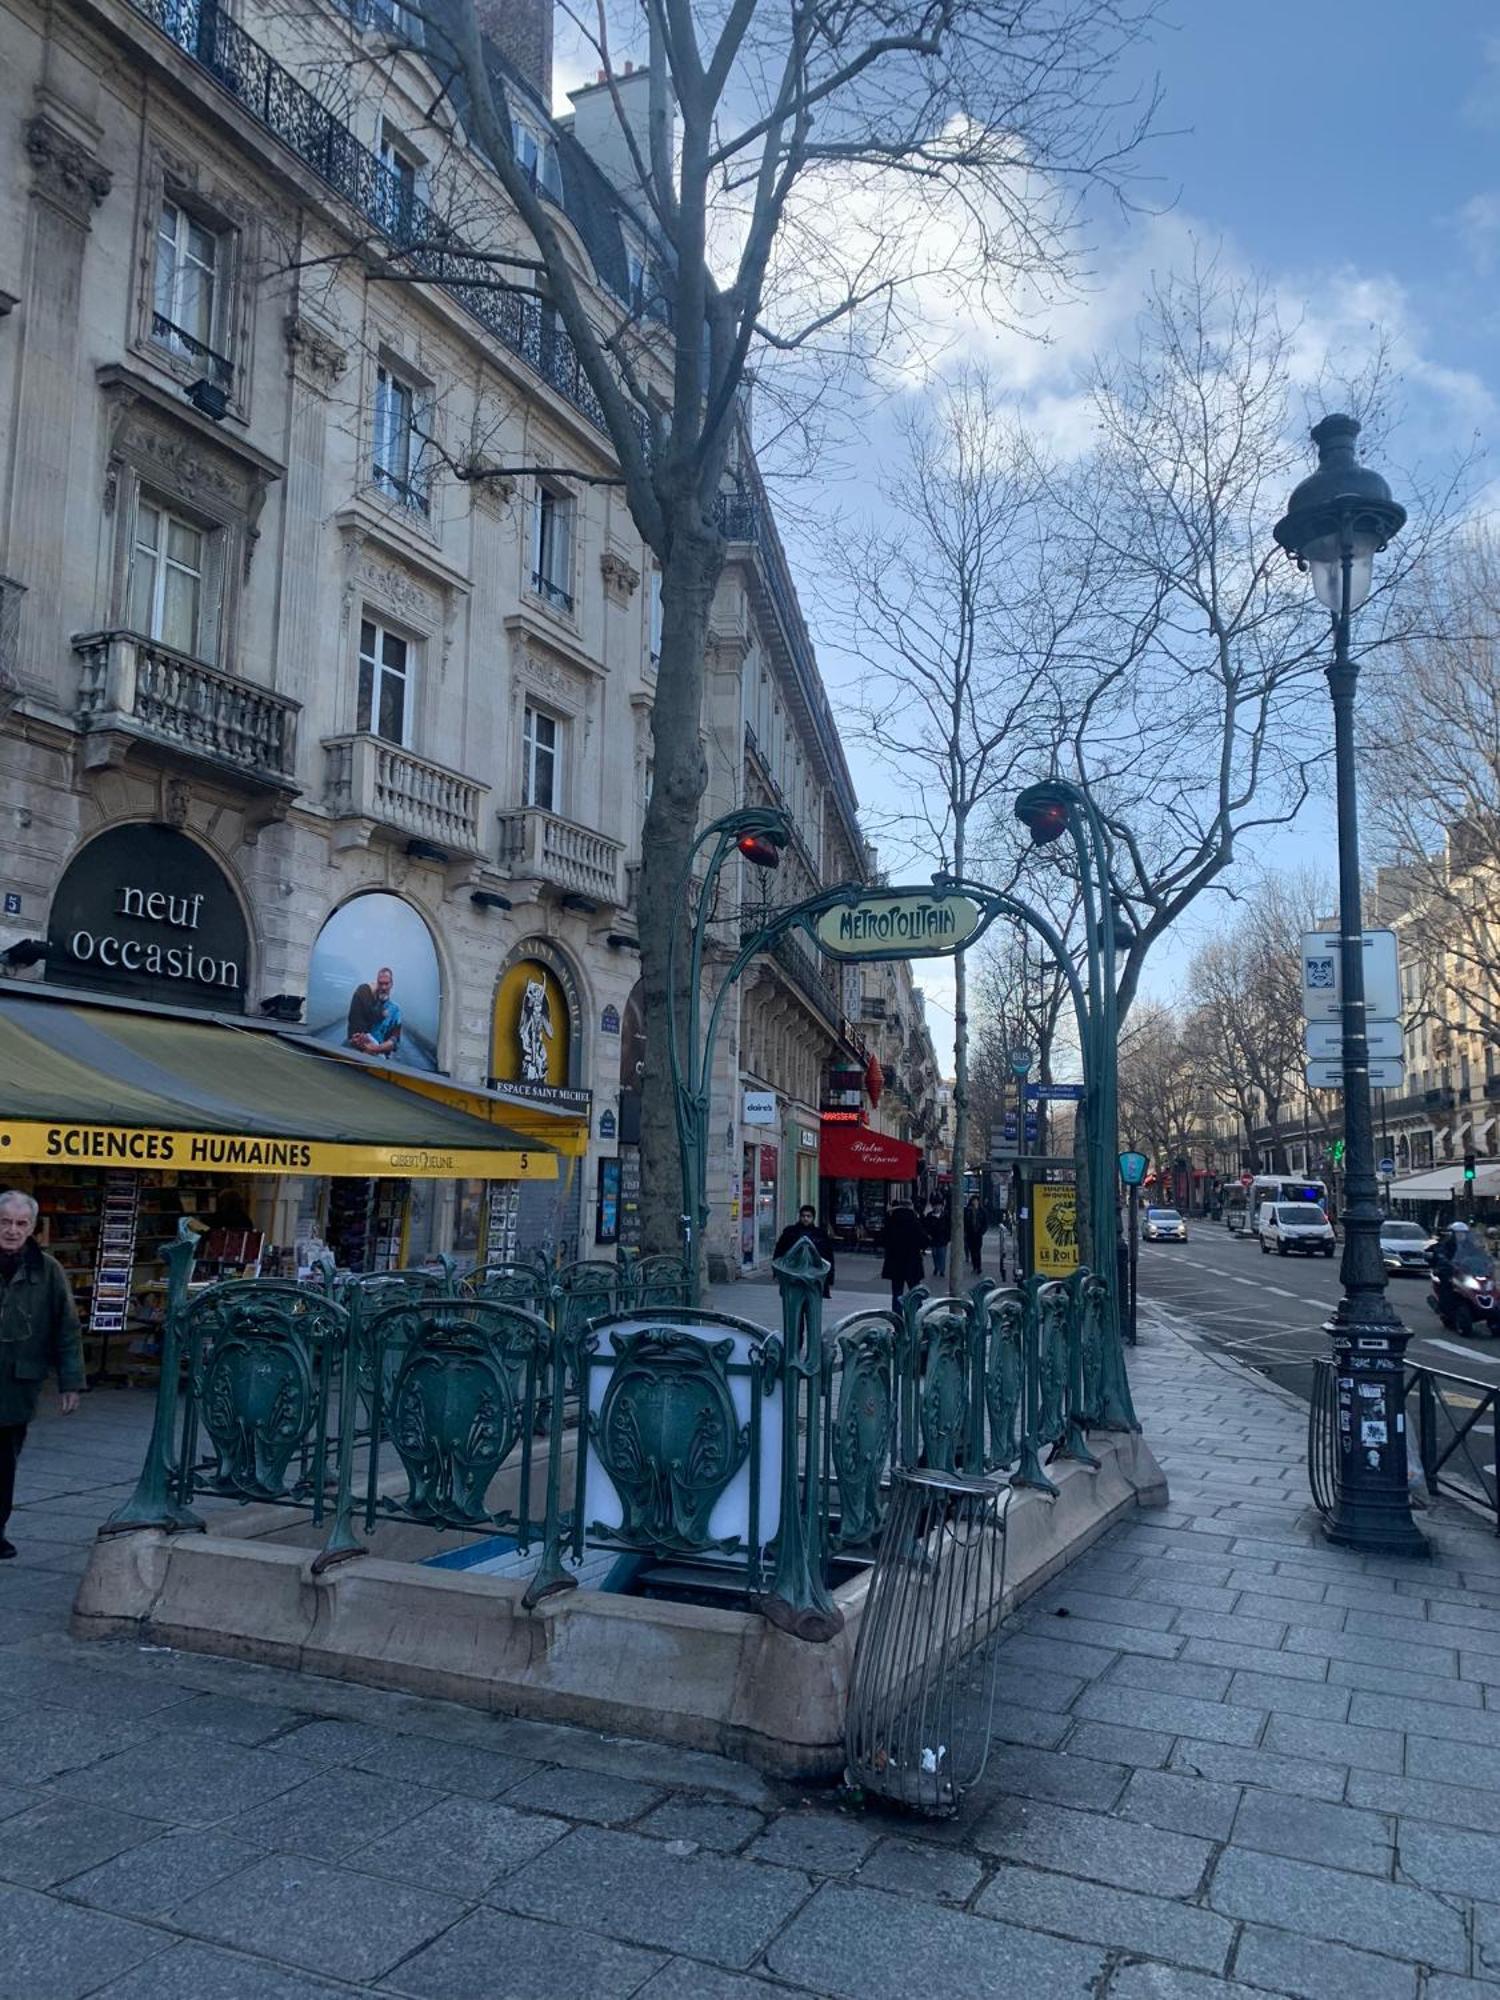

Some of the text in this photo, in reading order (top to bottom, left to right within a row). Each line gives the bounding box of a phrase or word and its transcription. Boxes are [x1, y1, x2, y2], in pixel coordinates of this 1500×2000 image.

[122, 887, 204, 929] neuf
[72, 931, 240, 988] occasion
[497, 1082, 591, 1102] ESPACE SAINT MICHEL
[46, 1129, 312, 1167] SCIENCES HUMAINES
[519, 1153, 529, 1169] 5
